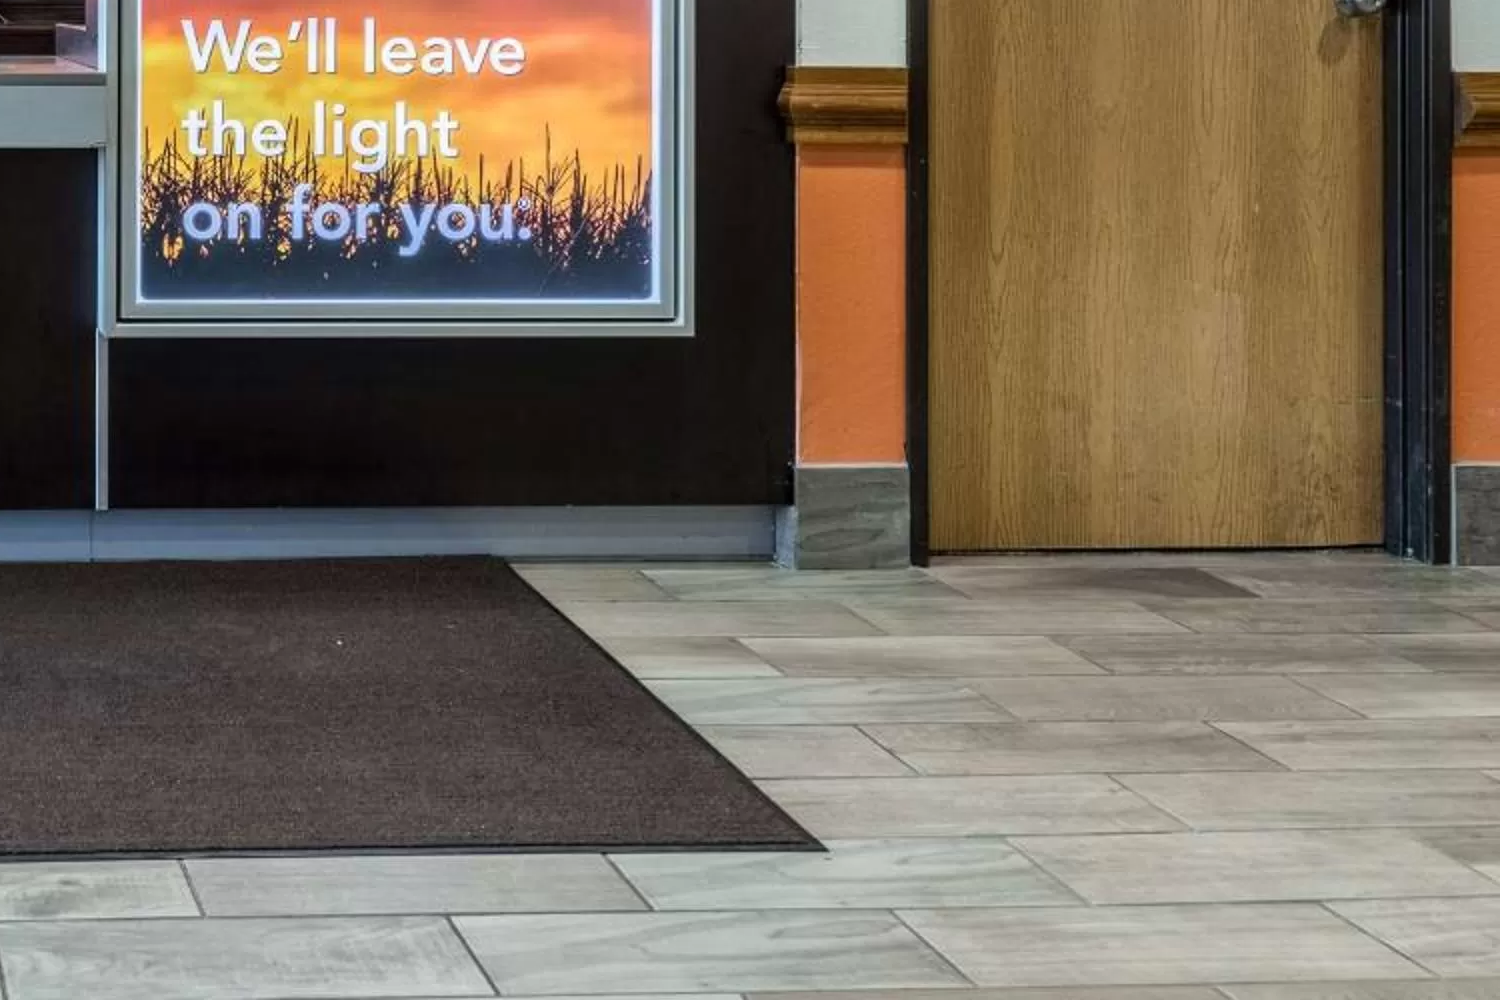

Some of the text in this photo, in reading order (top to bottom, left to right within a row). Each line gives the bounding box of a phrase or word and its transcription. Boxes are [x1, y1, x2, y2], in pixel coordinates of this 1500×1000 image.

[180, 17, 527, 76] We’ll leave
[181, 100, 461, 174] the light
[182, 183, 533, 258] on for you.
